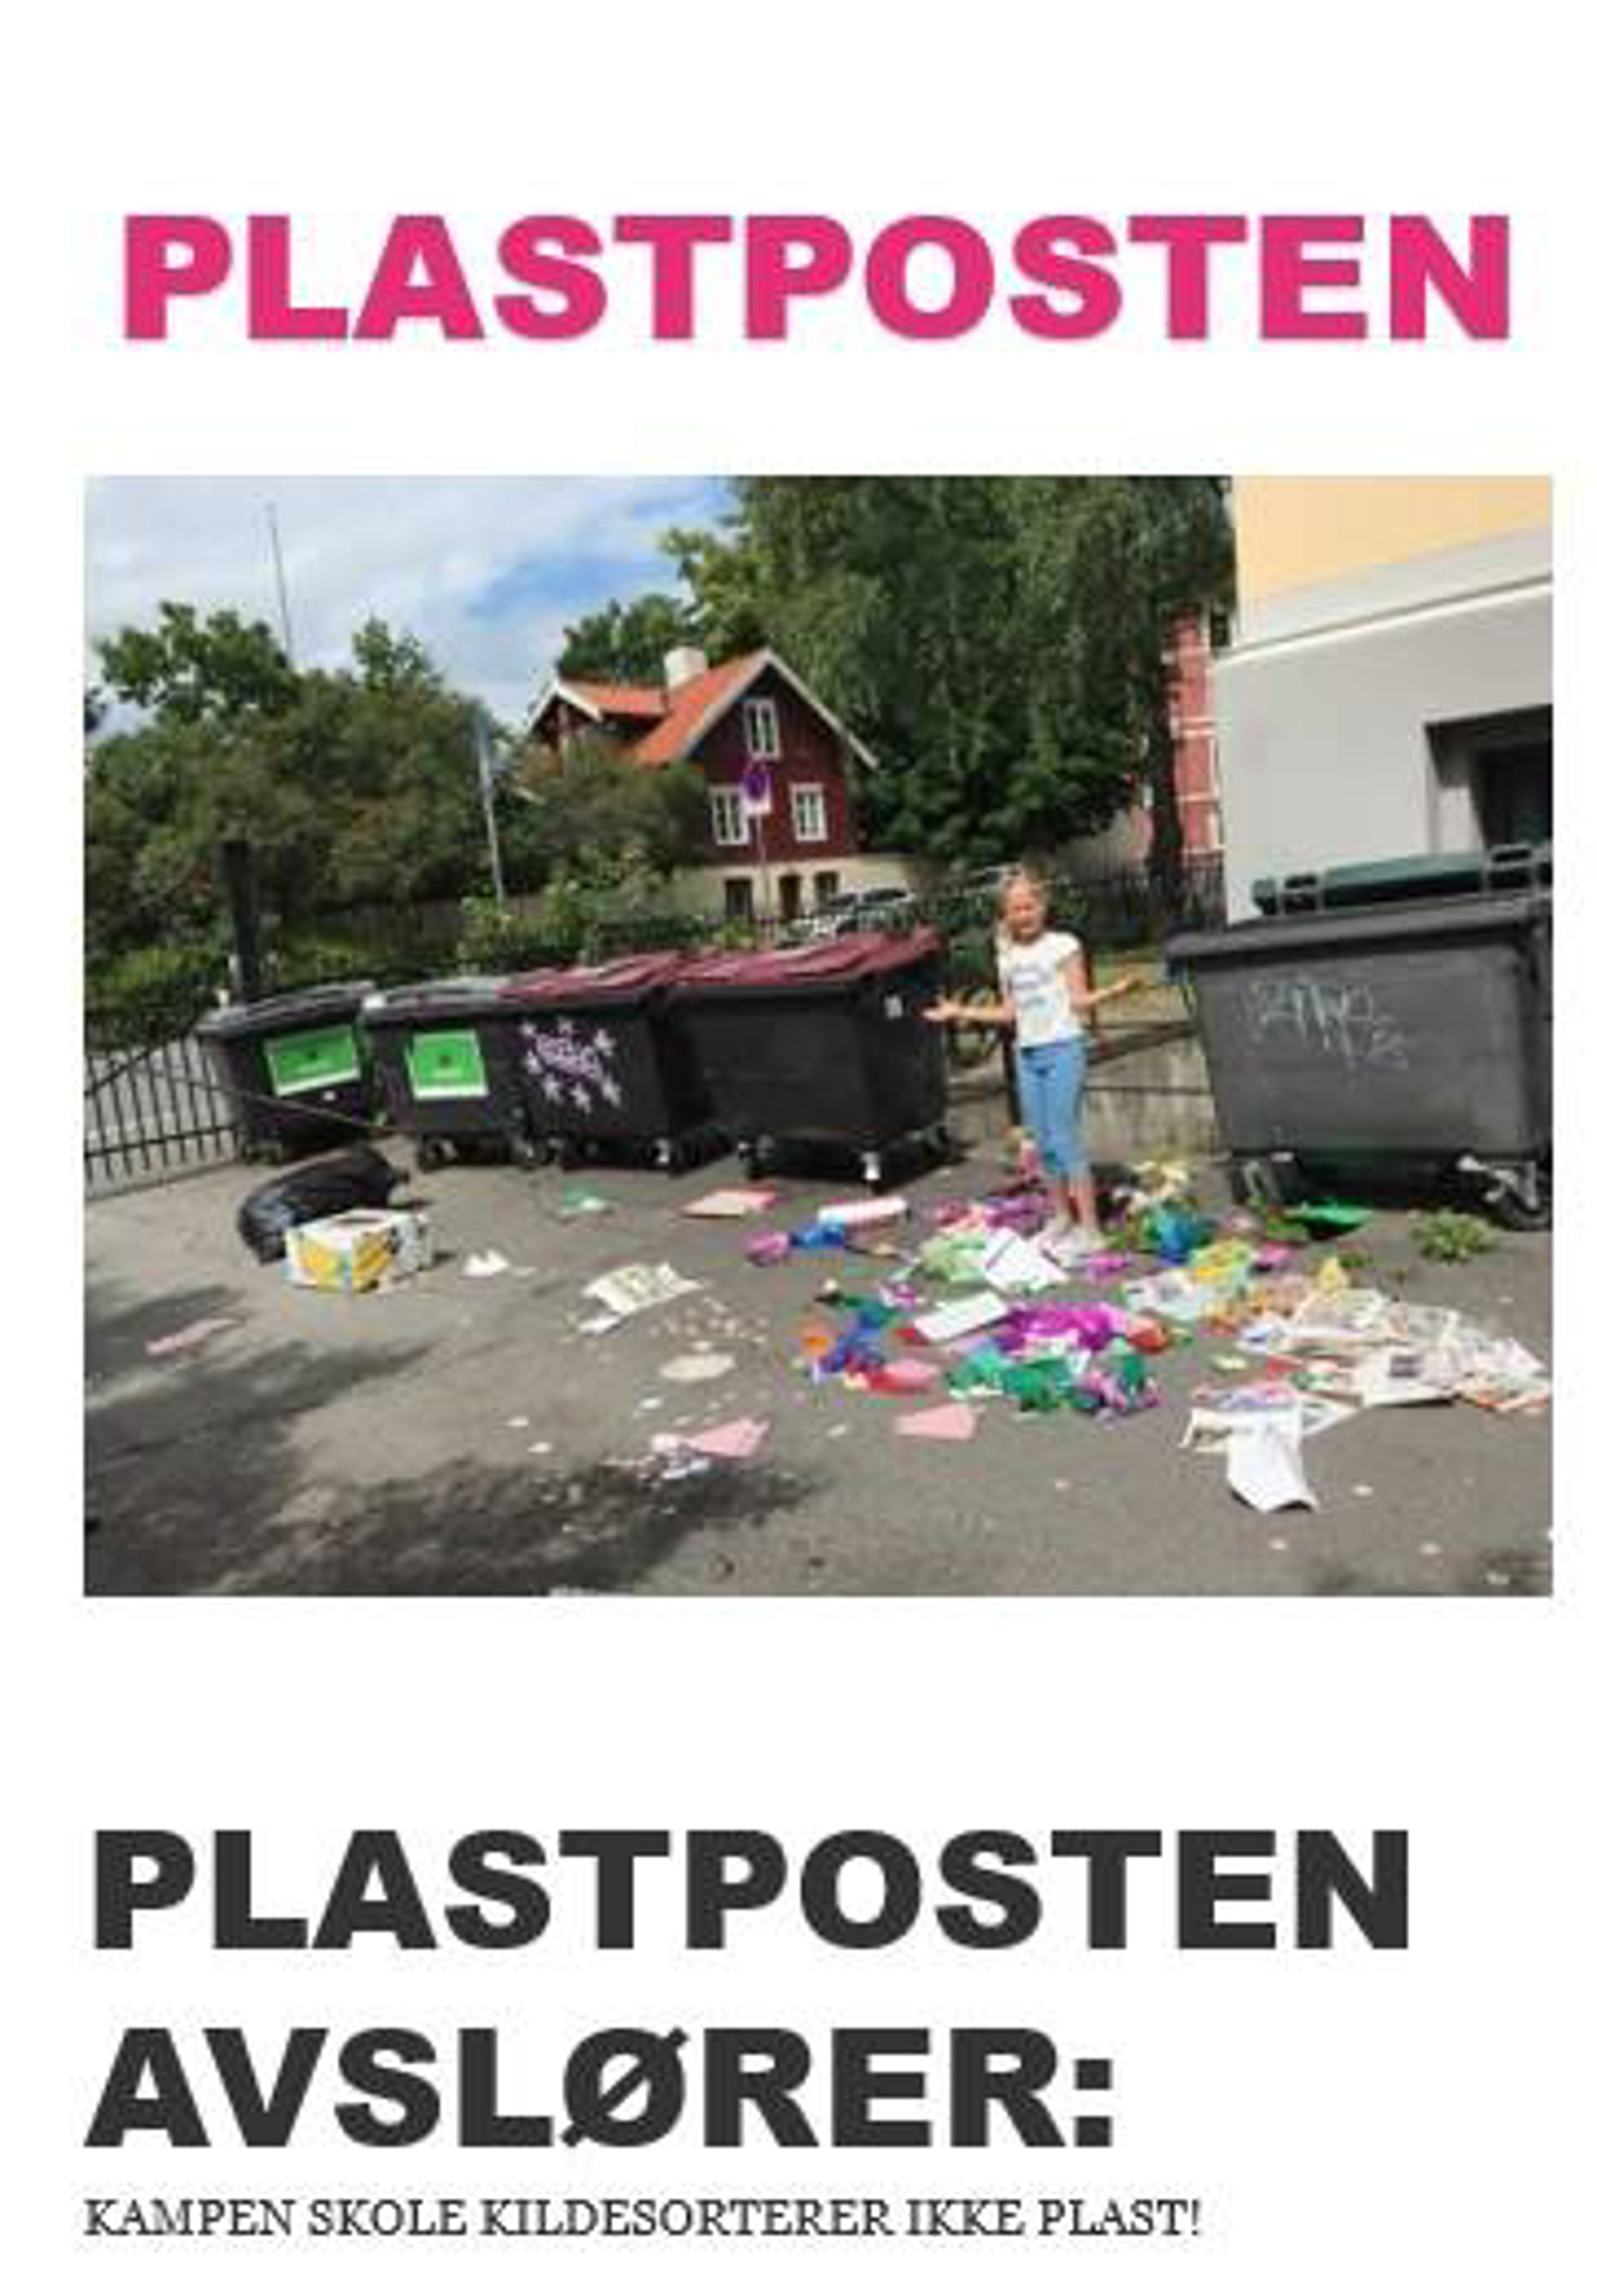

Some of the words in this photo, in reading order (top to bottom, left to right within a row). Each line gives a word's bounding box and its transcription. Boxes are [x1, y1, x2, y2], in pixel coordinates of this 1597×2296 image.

[123, 215, 1510, 341] PLASTPOSTEN
[94, 1830, 1409, 1949] PLASTPOSTEN
[84, 2028, 1113, 2147] AVSLØRER:
[84, 2199, 295, 2235] KAMPEN
[308, 2199, 468, 2235] SKOLE
[480, 2199, 895, 2235] KILDESORTERER
[906, 2199, 1025, 2235] IKKE
[1037, 2199, 1199, 2235] PLAST!
